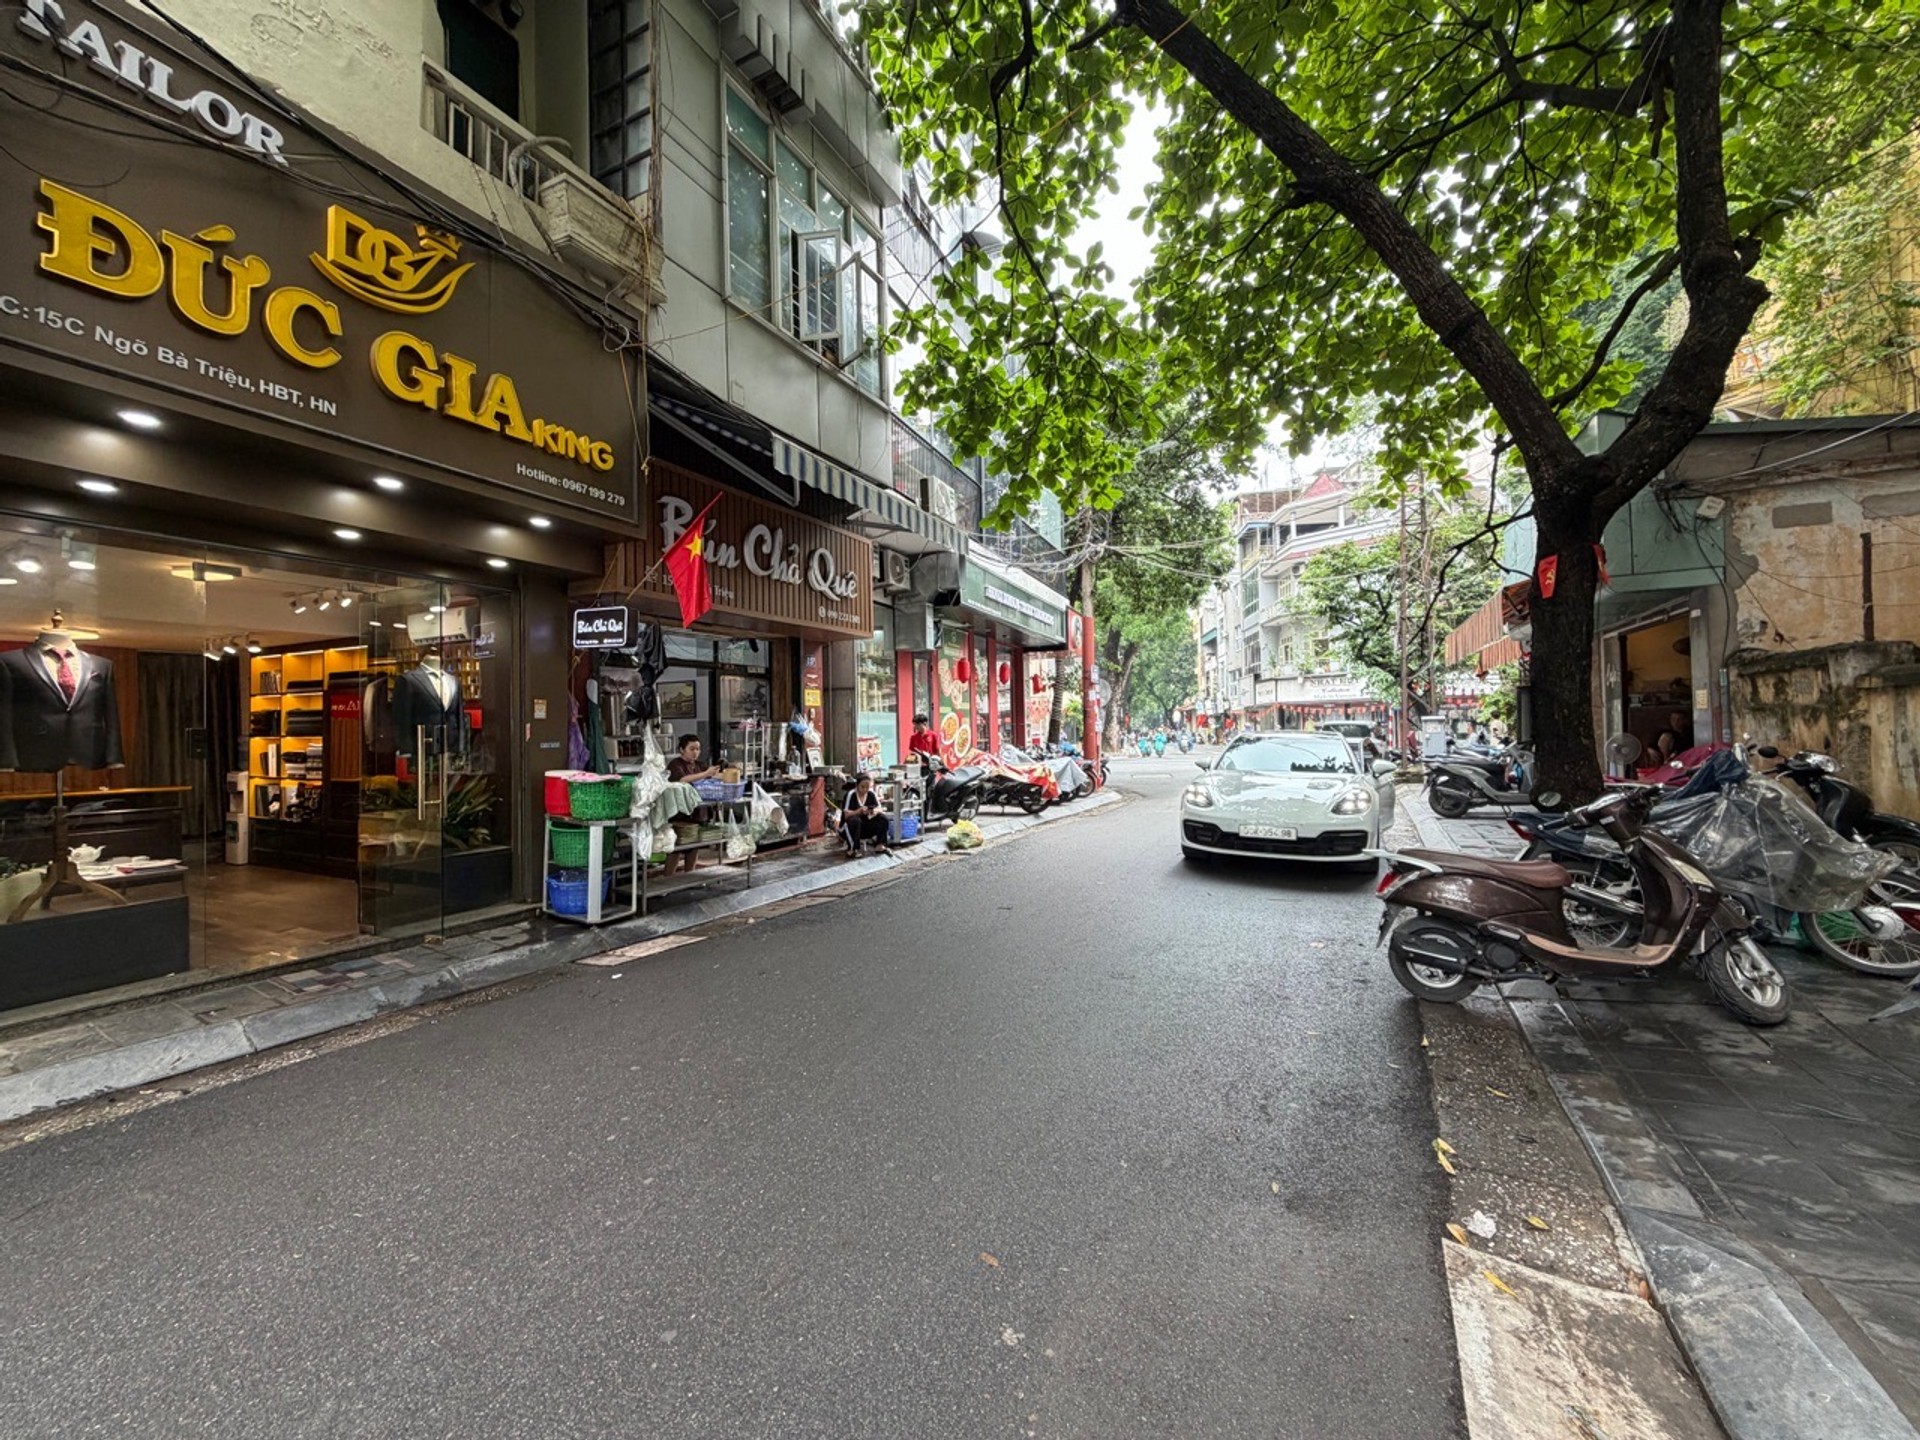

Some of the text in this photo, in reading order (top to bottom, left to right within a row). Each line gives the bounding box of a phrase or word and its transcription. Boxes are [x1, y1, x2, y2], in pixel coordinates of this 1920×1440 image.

[34, 306, 85, 336] 15C
[95, 325, 148, 356] Ngõ
[195, 358, 255, 393] Triệu,
[259, 379, 304, 408] HBT,
[310, 396, 337, 416] HN
[37, 178, 615, 471] ĐỨC GIA KING
[516, 462, 626, 507] Hotline: 0967 199 279
[743, 523, 803, 585] Chả
[807, 547, 858, 601] Quê
